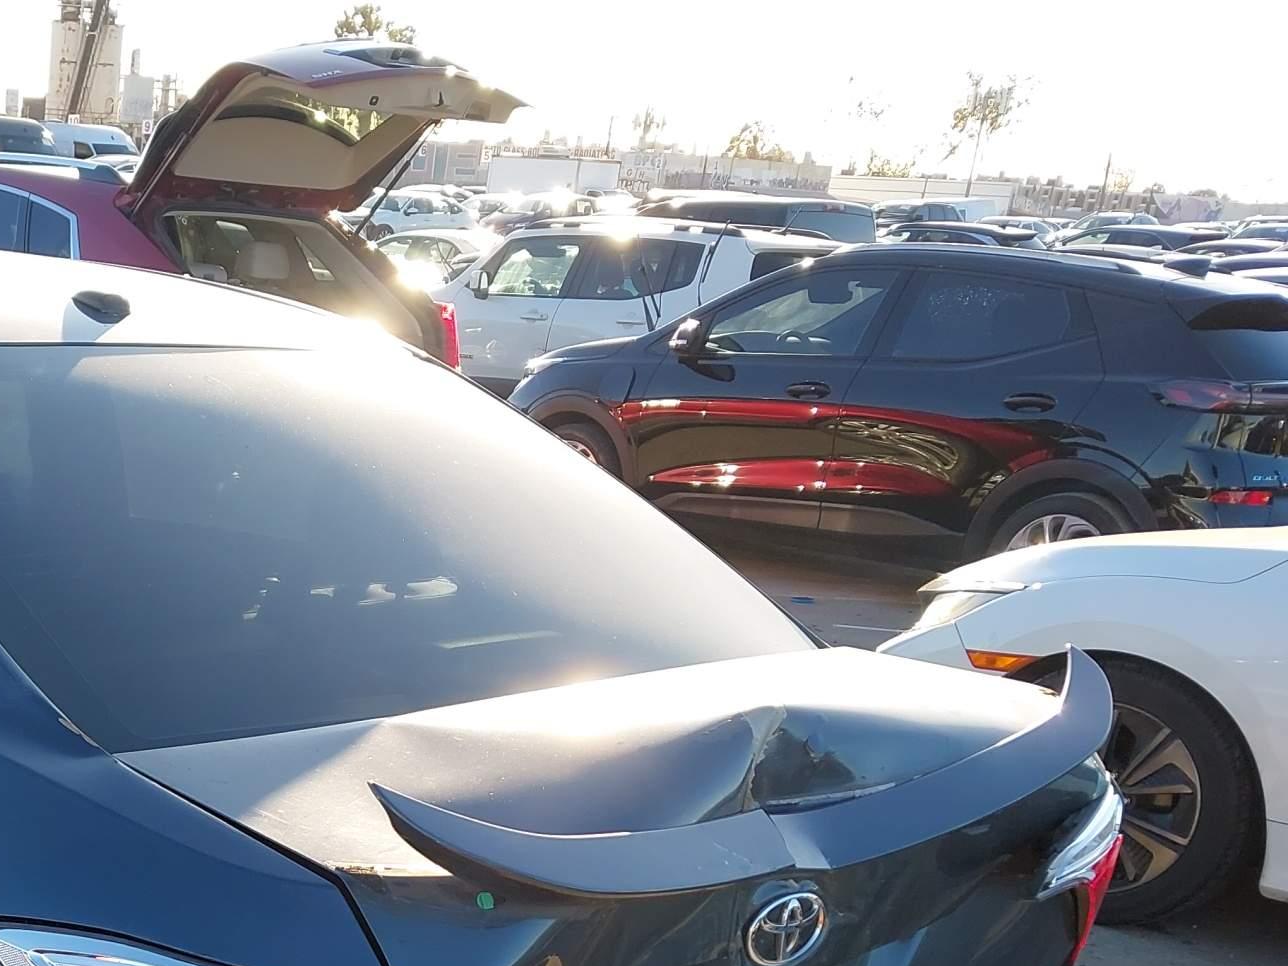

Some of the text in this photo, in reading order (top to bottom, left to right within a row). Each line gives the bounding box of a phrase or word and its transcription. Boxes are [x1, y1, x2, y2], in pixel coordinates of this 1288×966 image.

[144, 121, 151, 132] 9
[421, 146, 427, 156] 6
[483, 150, 490, 161] 5
